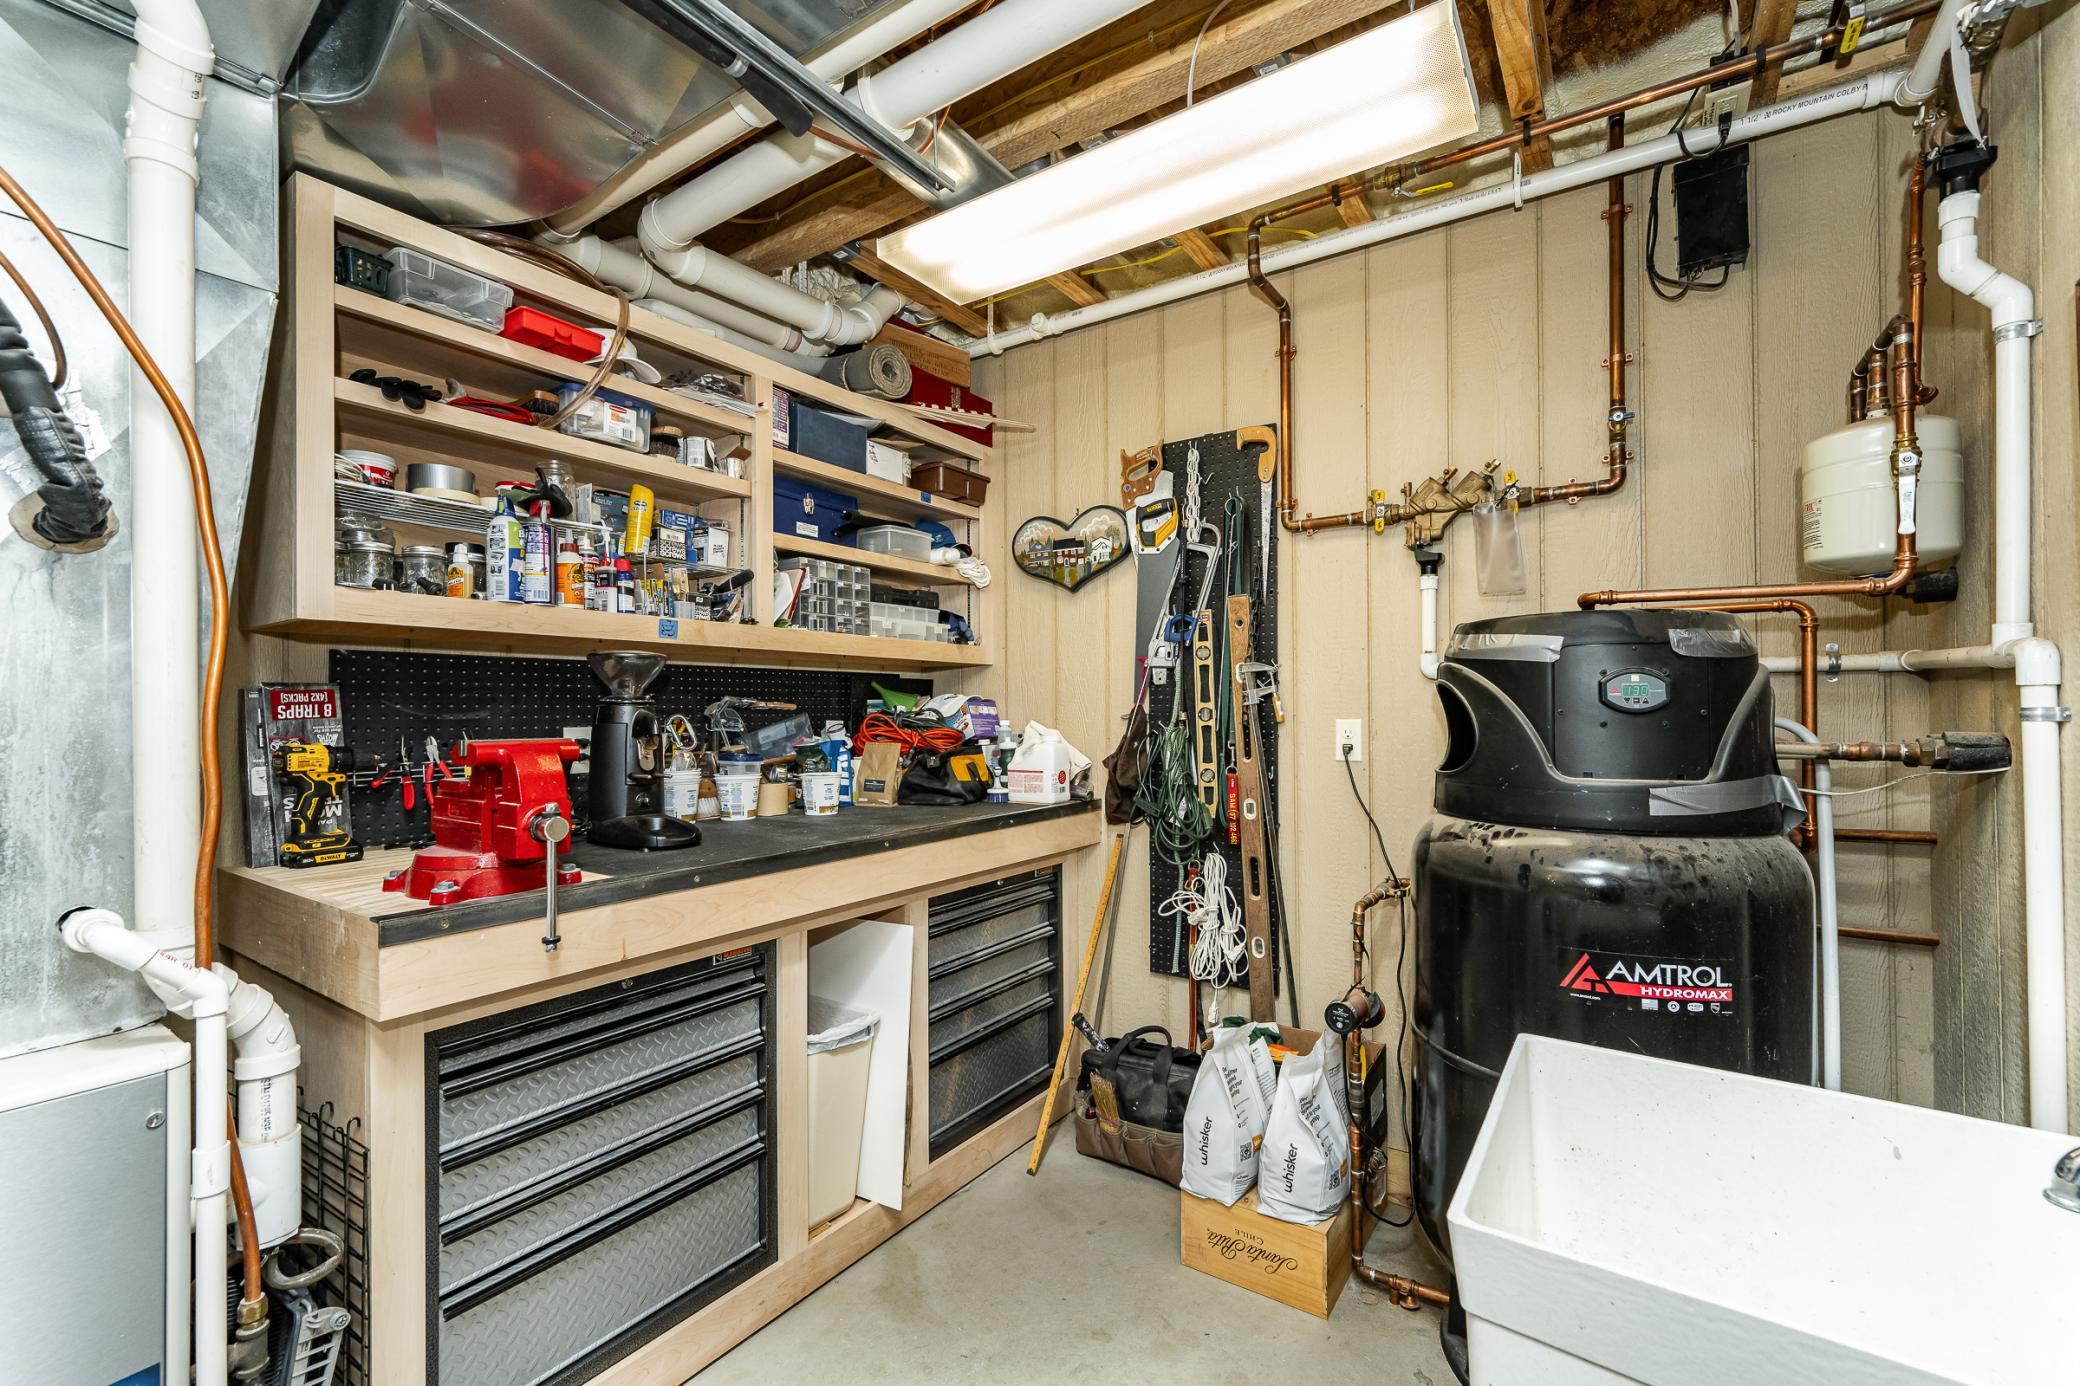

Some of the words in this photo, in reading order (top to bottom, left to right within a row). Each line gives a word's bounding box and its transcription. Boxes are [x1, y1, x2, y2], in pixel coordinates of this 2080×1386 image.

[1772, 103, 1797, 115] ROCKY
[1797, 92, 1835, 108] MOUNTAIN
[1836, 85, 1861, 98] COLBY
[277, 704, 320, 719] TRAPS
[323, 703, 332, 717] 8
[1605, 960, 1730, 987] AMTROL
[1641, 986, 1729, 1000] HYDROMAX
[1200, 1116, 1213, 1166] whisker
[1281, 1143, 1299, 1192] whisker
[1235, 1229, 1264, 1246] CHILE
[1247, 1244, 1298, 1274] Santa
